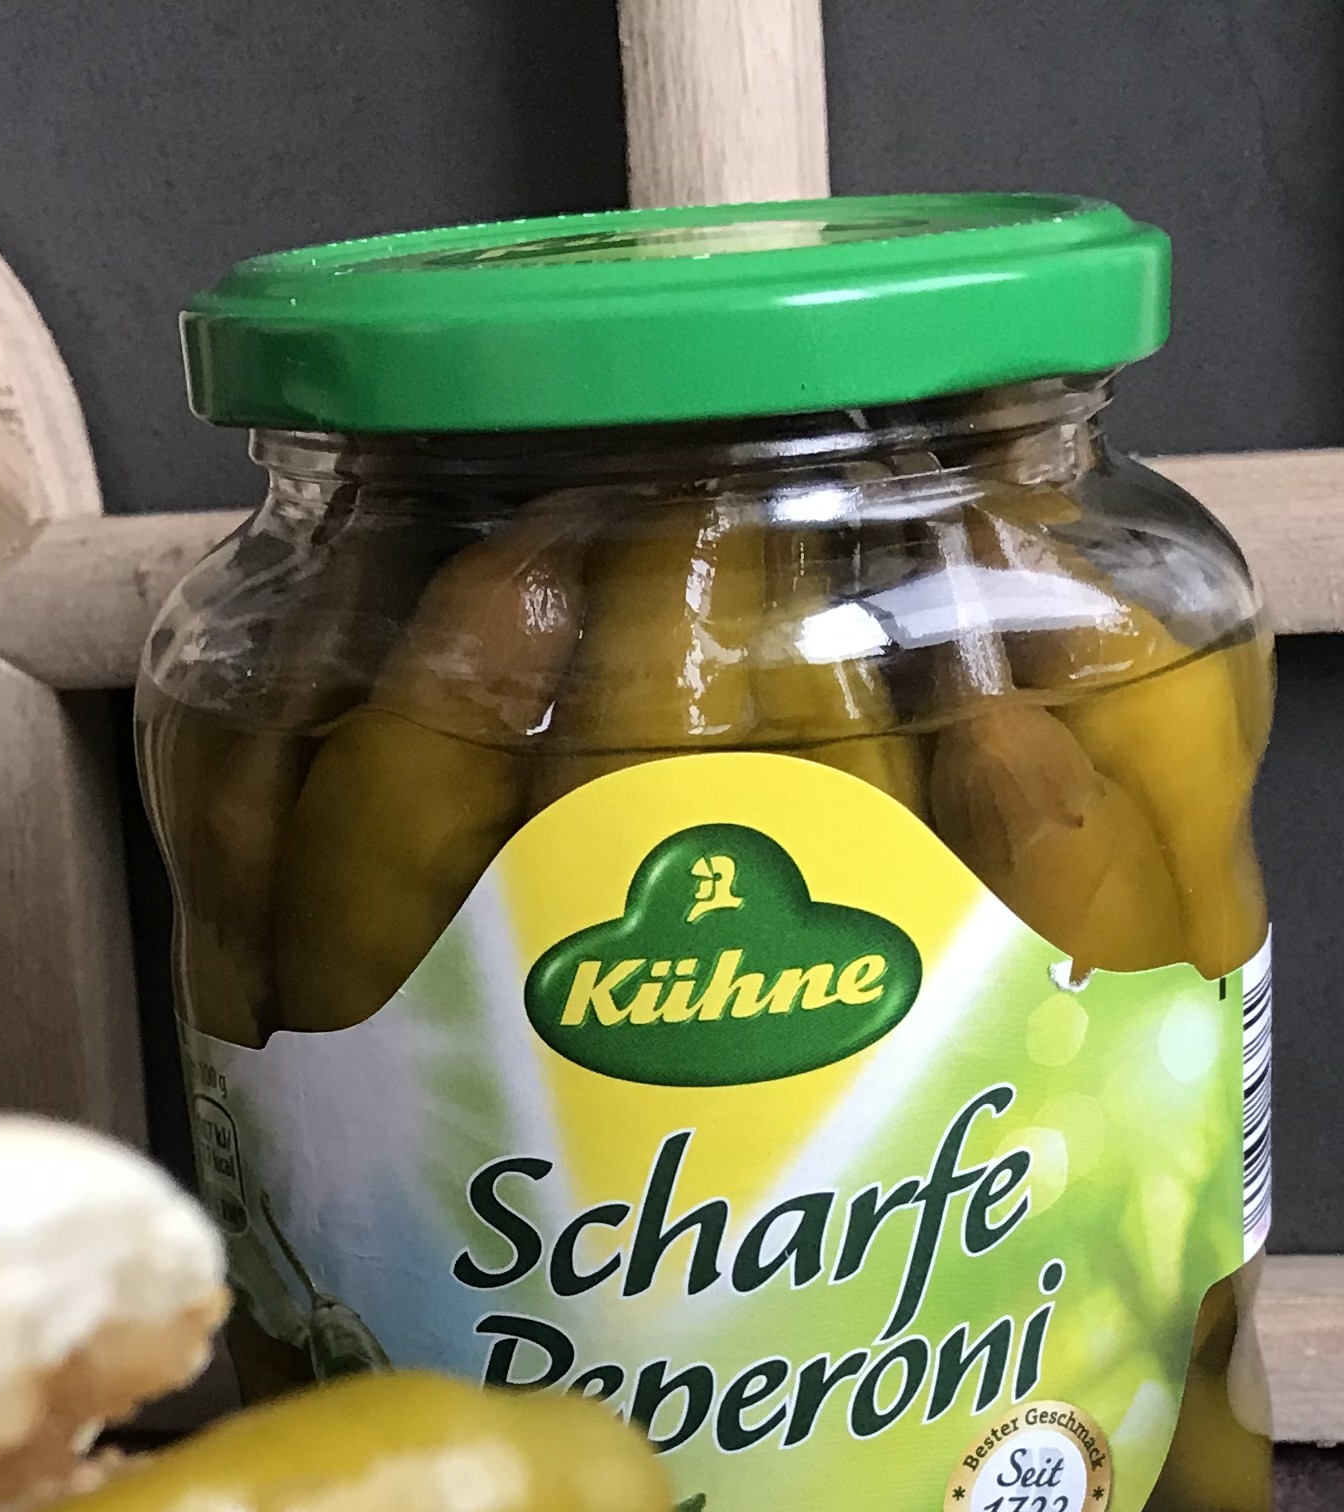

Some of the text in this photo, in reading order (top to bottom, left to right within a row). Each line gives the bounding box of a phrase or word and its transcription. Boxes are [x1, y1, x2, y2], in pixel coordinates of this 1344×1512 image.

[559, 948, 888, 1027] Kühne
[452, 1082, 1033, 1343] Scharfe
[962, 1407, 1107, 1472] Bester Geschmack
[995, 1447, 1065, 1488] Seit
